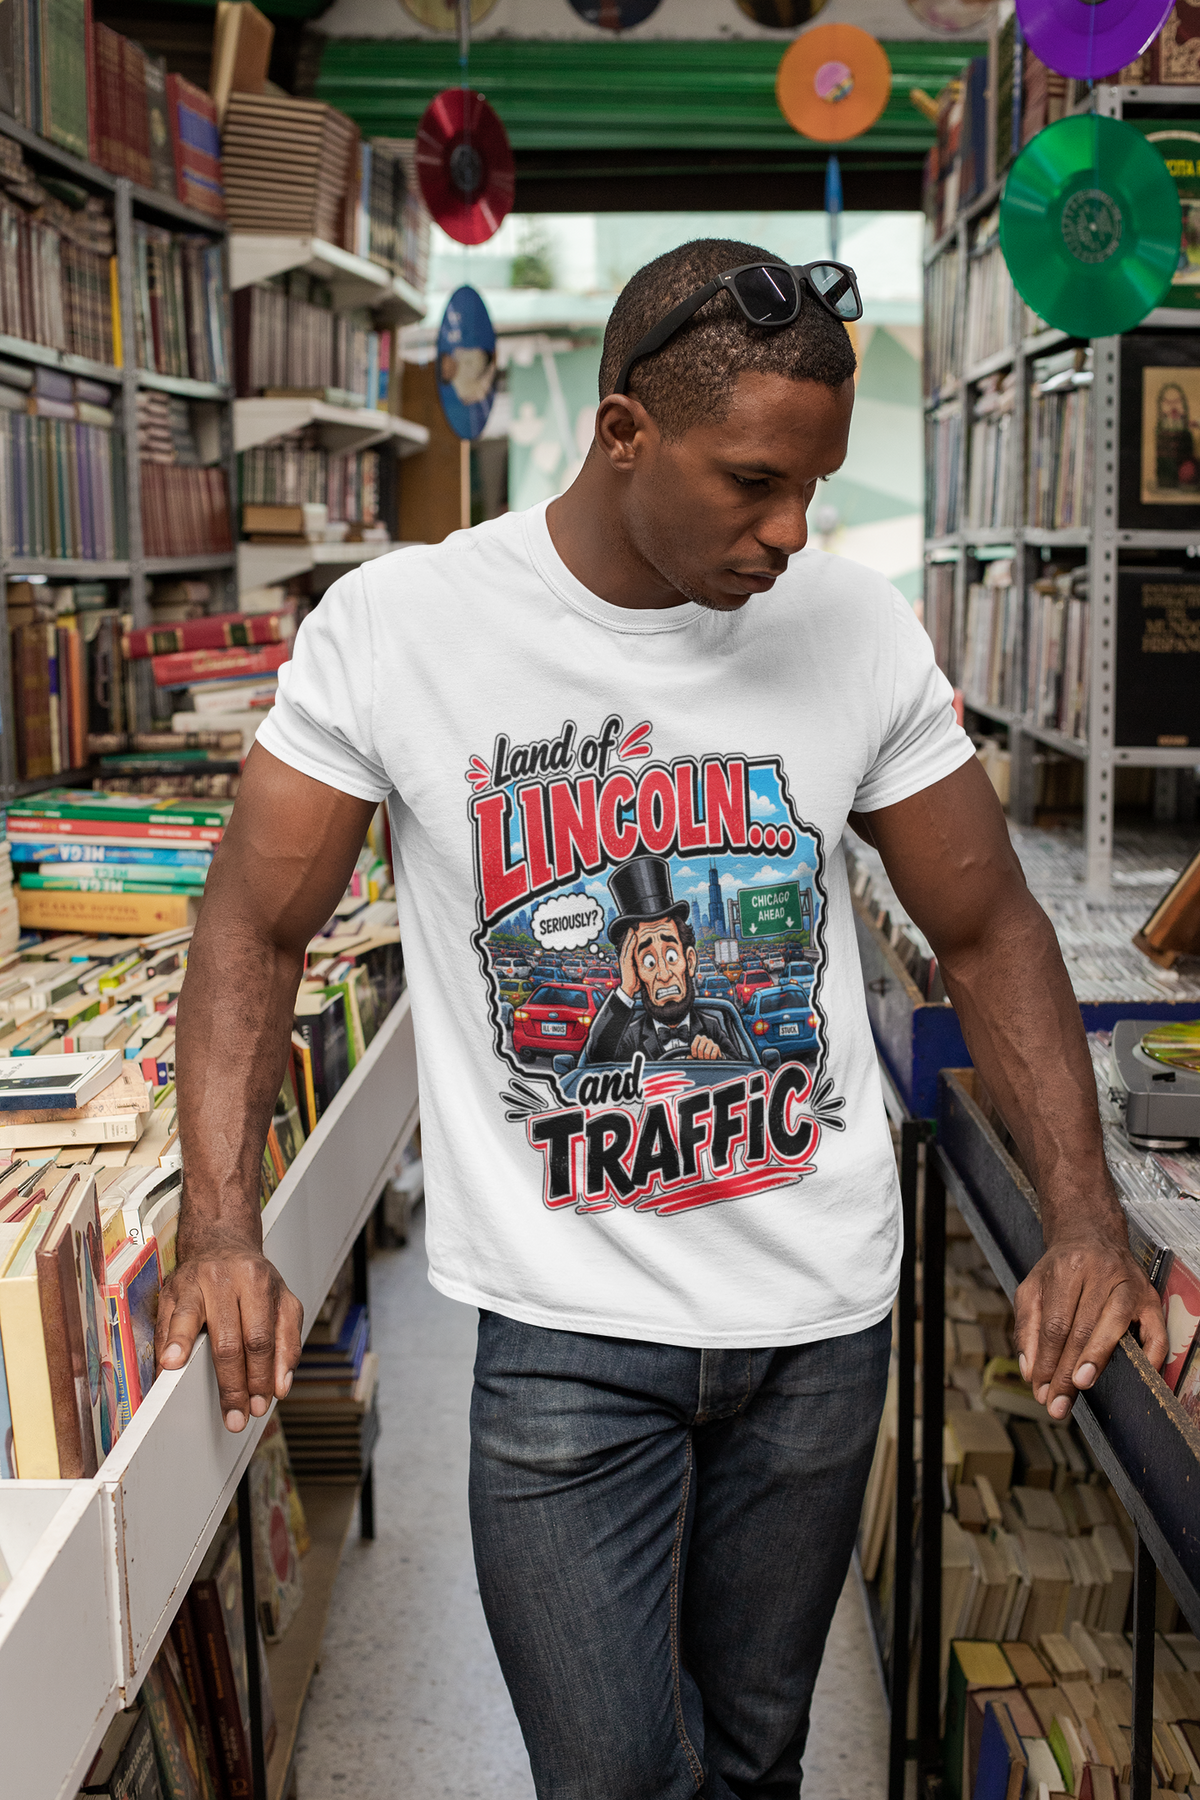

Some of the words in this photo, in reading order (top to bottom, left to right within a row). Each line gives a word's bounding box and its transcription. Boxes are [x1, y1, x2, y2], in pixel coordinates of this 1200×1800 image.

[494, 724, 574, 787] Land
[580, 718, 620, 778] of
[752, 891, 790, 908] CHICAGO
[540, 910, 599, 935] SERIOUSLY?
[758, 907, 786, 922] AHEAD
[780, 1025, 798, 1035] STUCK
[579, 1055, 643, 1106] and
